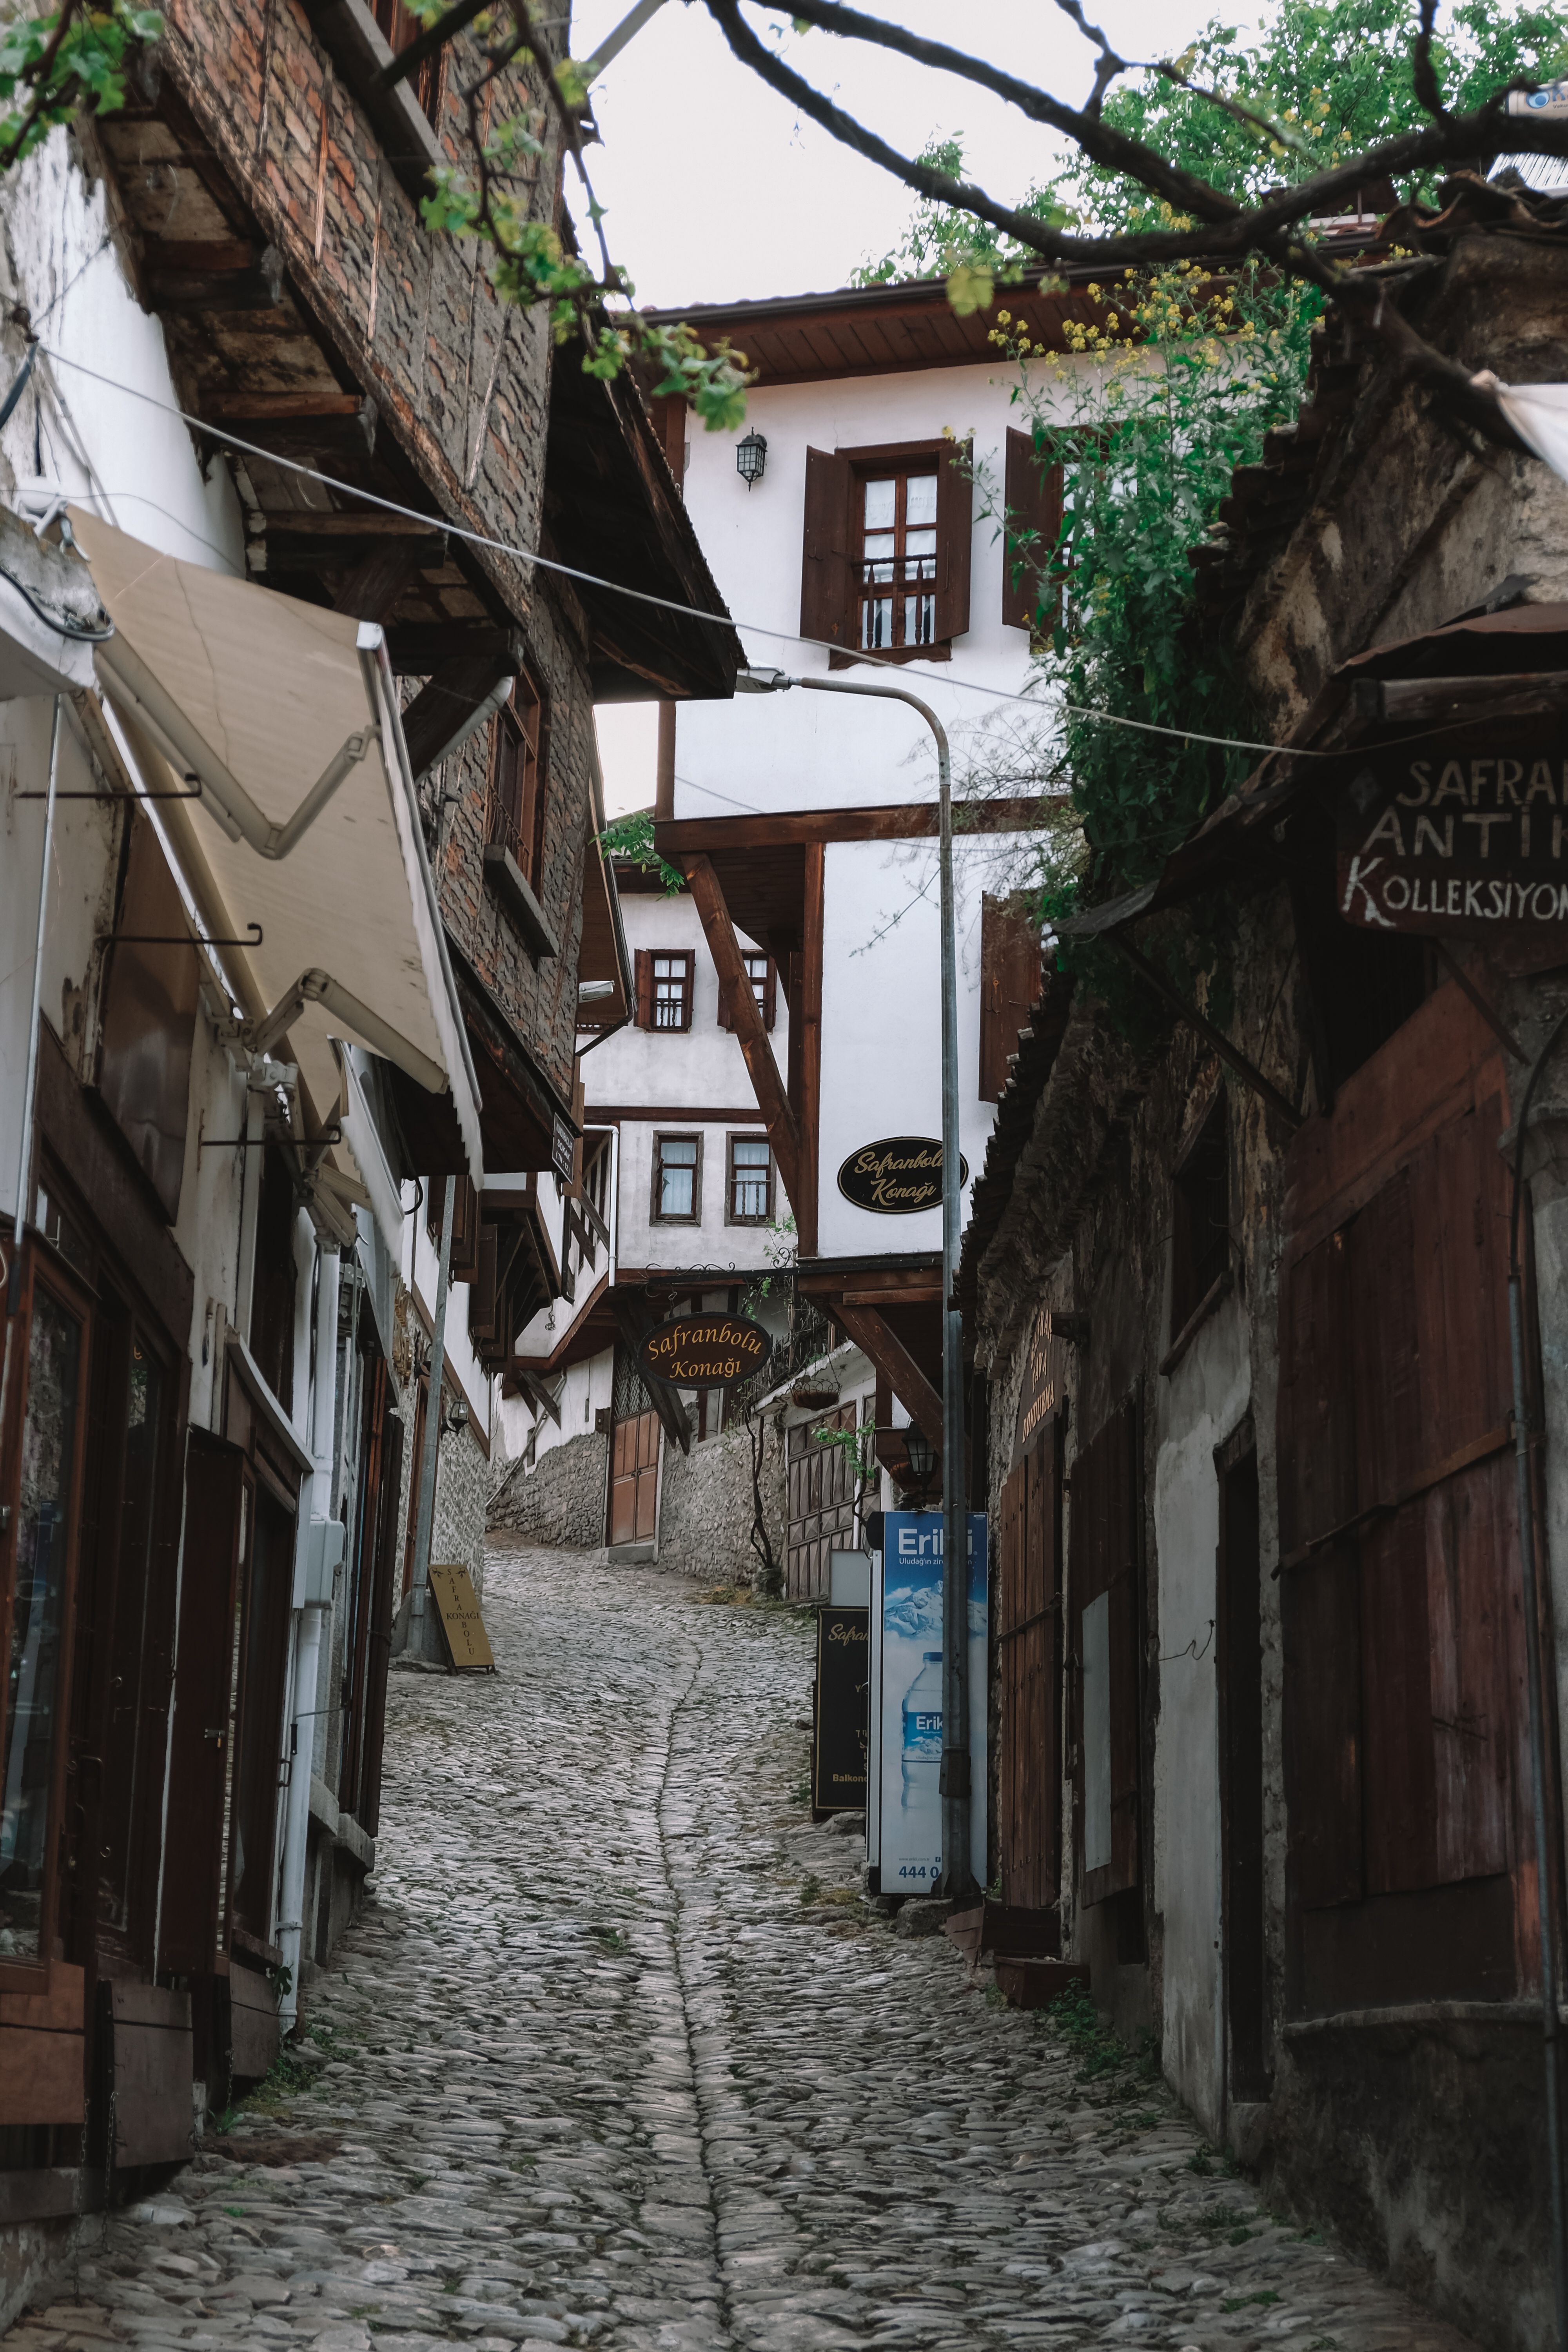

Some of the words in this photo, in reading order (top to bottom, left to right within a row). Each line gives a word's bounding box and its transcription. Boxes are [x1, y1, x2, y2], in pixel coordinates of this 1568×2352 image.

[1396, 759, 1568, 806] SAFRA
[557, 1139, 570, 1162] SOKAK
[854, 1149, 943, 1178] Safranbol
[870, 1179, 936, 1206] Konağı
[648, 1323, 762, 1360] Safranbolu
[669, 1357, 742, 1378] Konağı
[1022, 1379, 1054, 1444] DONDURMA
[898, 1528, 973, 1555] Erii
[899, 1557, 931, 1566] Uludağ'ın
[446, 1611, 479, 1620] KONAĞI
[898, 1866, 927, 1878] 444
[930, 1866, 939, 1879] 0
